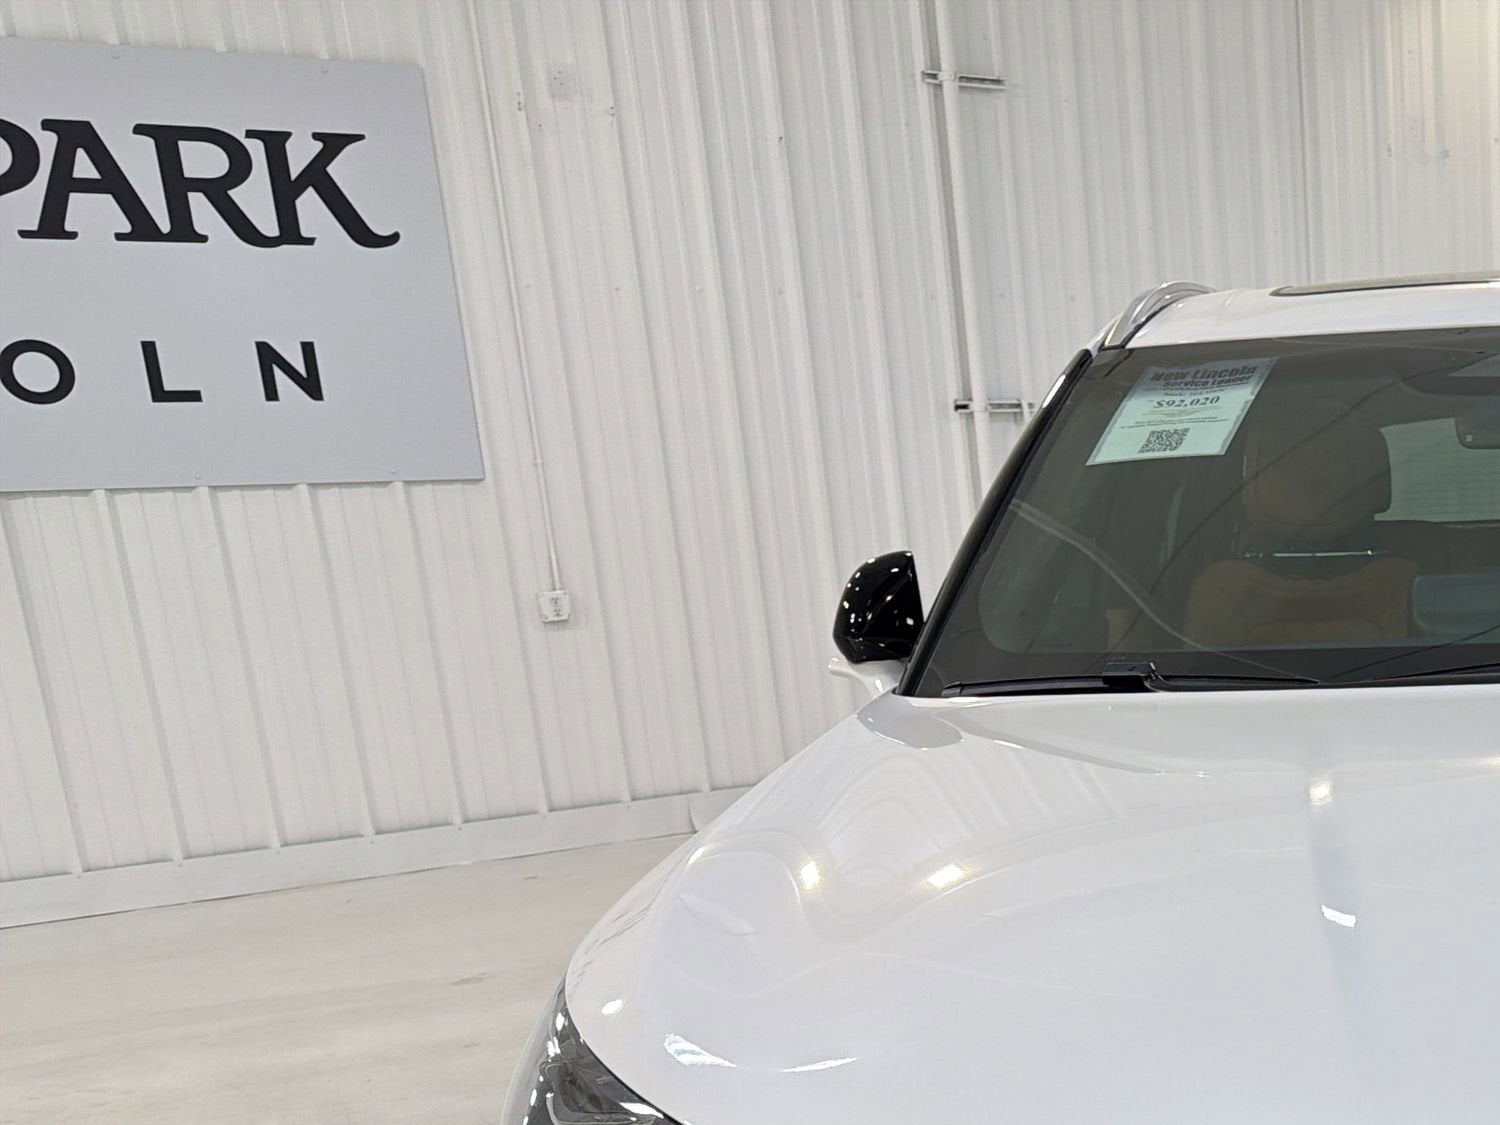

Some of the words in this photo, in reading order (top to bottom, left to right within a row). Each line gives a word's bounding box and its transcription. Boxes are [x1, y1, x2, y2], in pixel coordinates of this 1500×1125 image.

[1151, 371, 1190, 382] New
[1191, 365, 1259, 380] Lincoln
[1162, 379, 1212, 389] Service
[1153, 395, 1221, 409] $92,020
